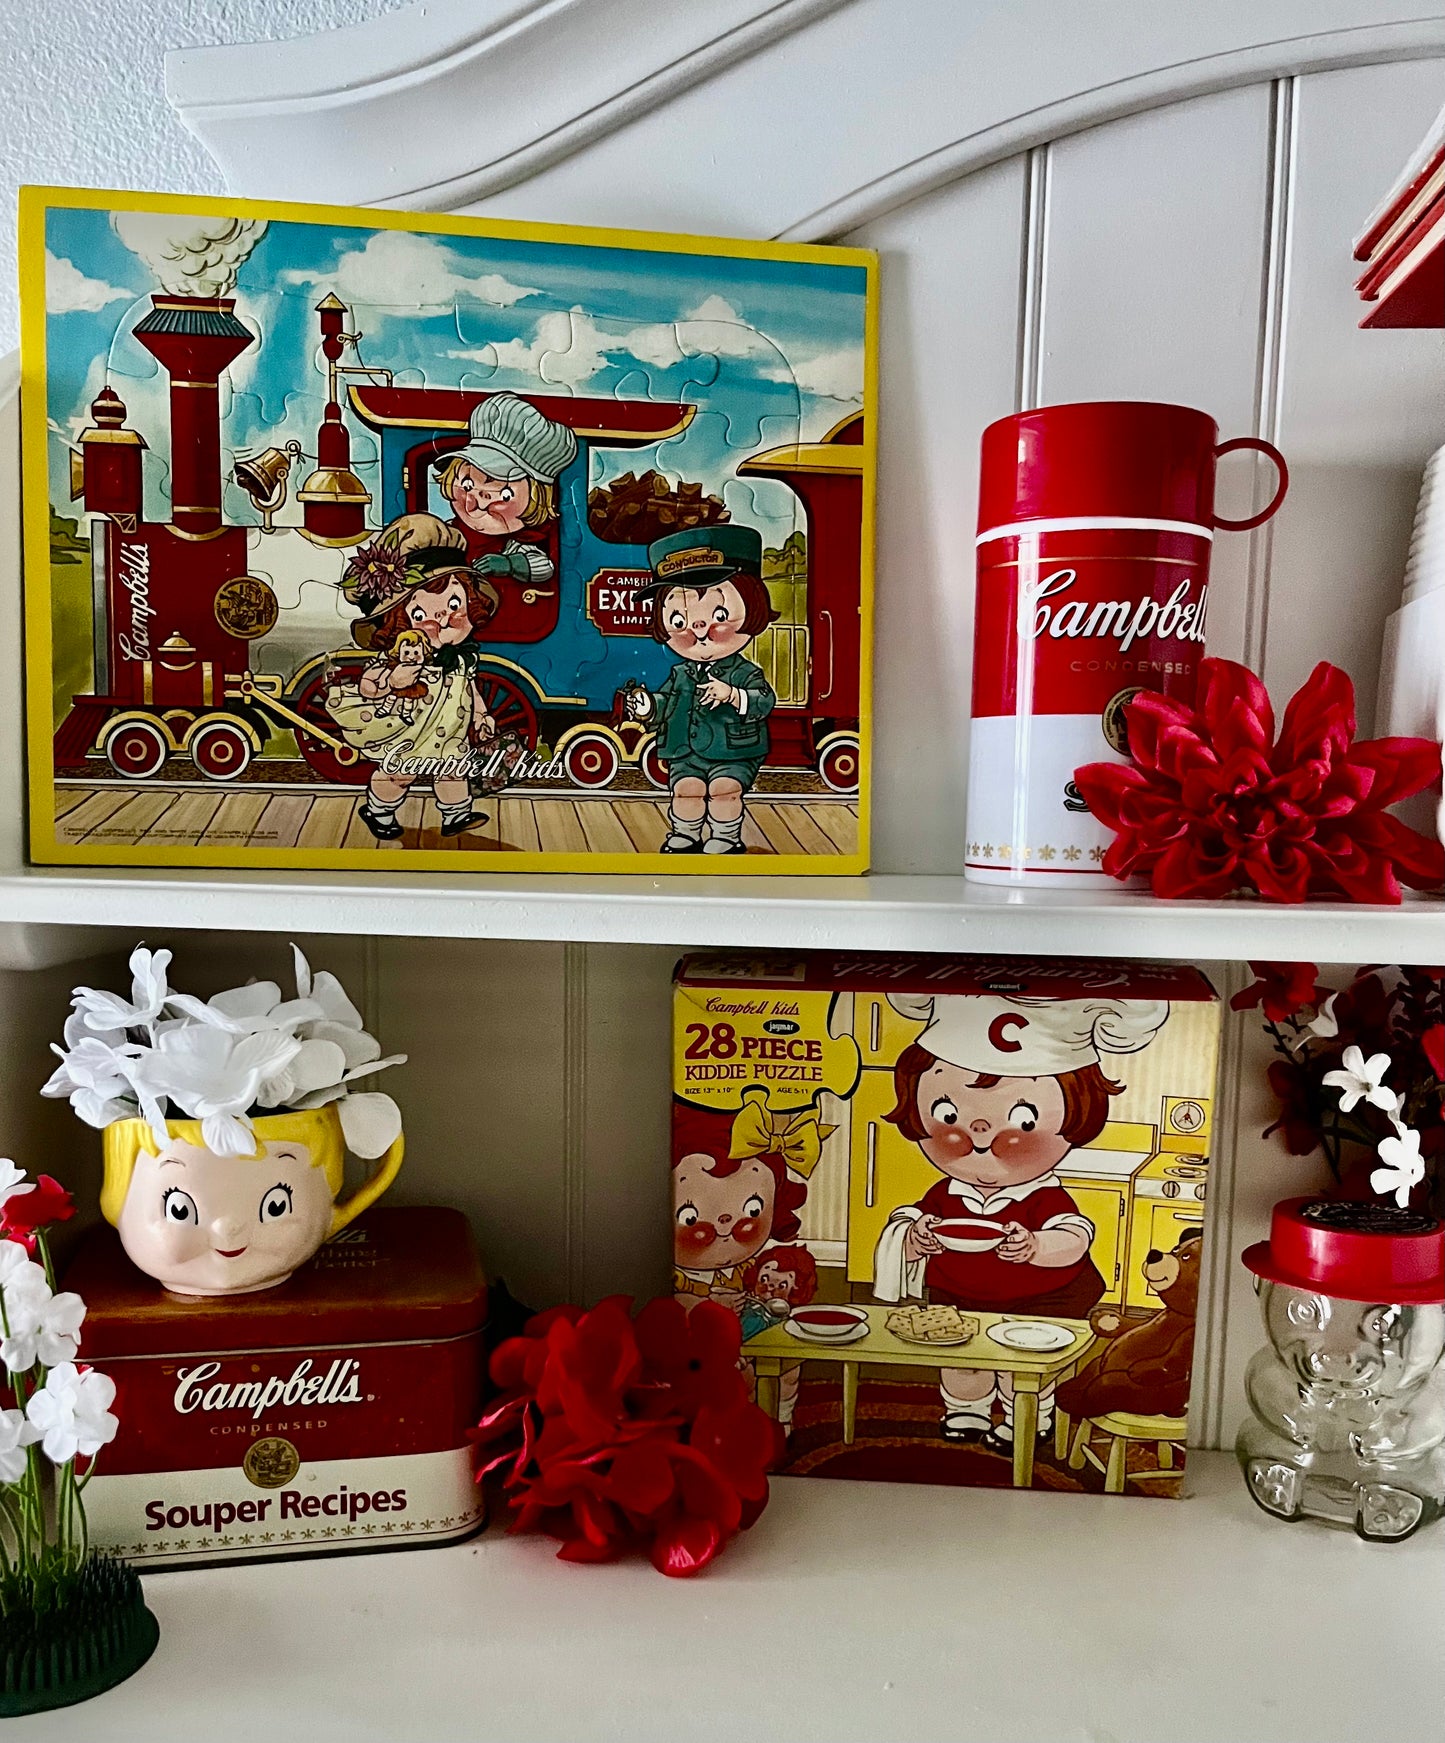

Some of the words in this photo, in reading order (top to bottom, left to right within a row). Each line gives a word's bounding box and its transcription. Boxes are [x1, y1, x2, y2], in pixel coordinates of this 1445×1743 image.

[662, 554, 718, 572] CONDUCTOR
[119, 543, 157, 661] Campbell's
[1018, 569, 1209, 652] Campbell
[382, 741, 505, 783] Campbell
[706, 997, 769, 1016] Campbell
[685, 1023, 737, 1059] 28
[741, 1037, 823, 1061] PIECE
[988, 1012, 1029, 1053] C
[685, 1064, 747, 1080] KIDDIE
[753, 1064, 823, 1081] PUZZLE
[174, 1359, 363, 1419] Campbell's
[210, 1420, 328, 1435] CONDENSED
[145, 1499, 272, 1533] Souper
[280, 1485, 407, 1522] Recipes
